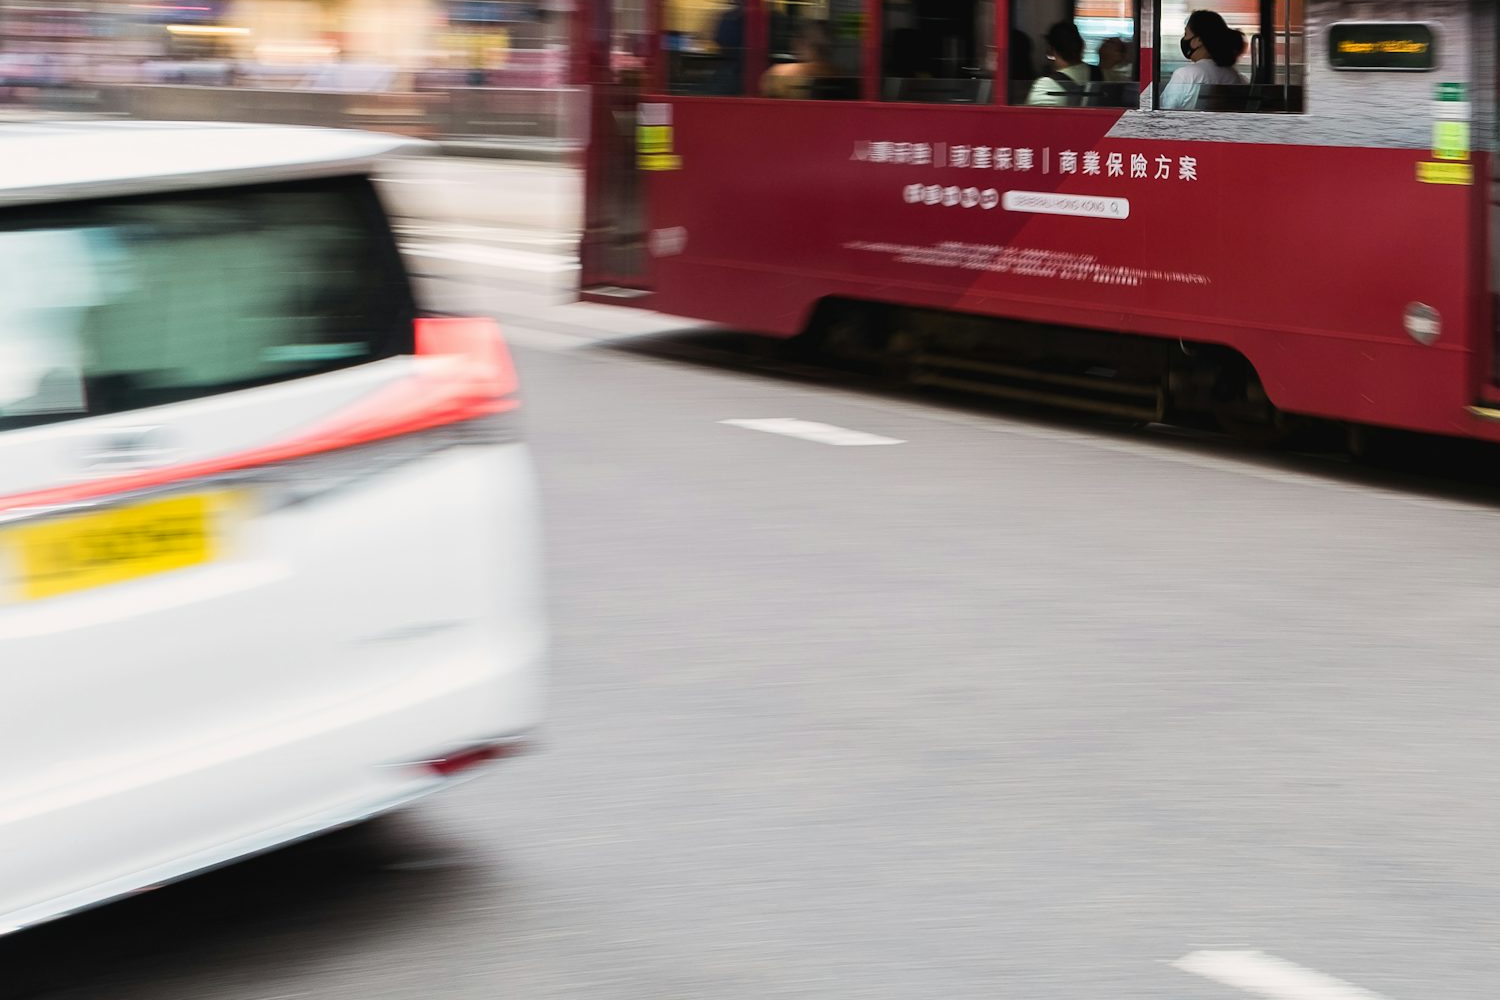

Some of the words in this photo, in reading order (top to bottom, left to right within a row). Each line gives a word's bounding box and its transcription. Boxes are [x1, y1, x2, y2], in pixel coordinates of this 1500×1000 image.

[1058, 149, 1198, 182] 商業保險方案
